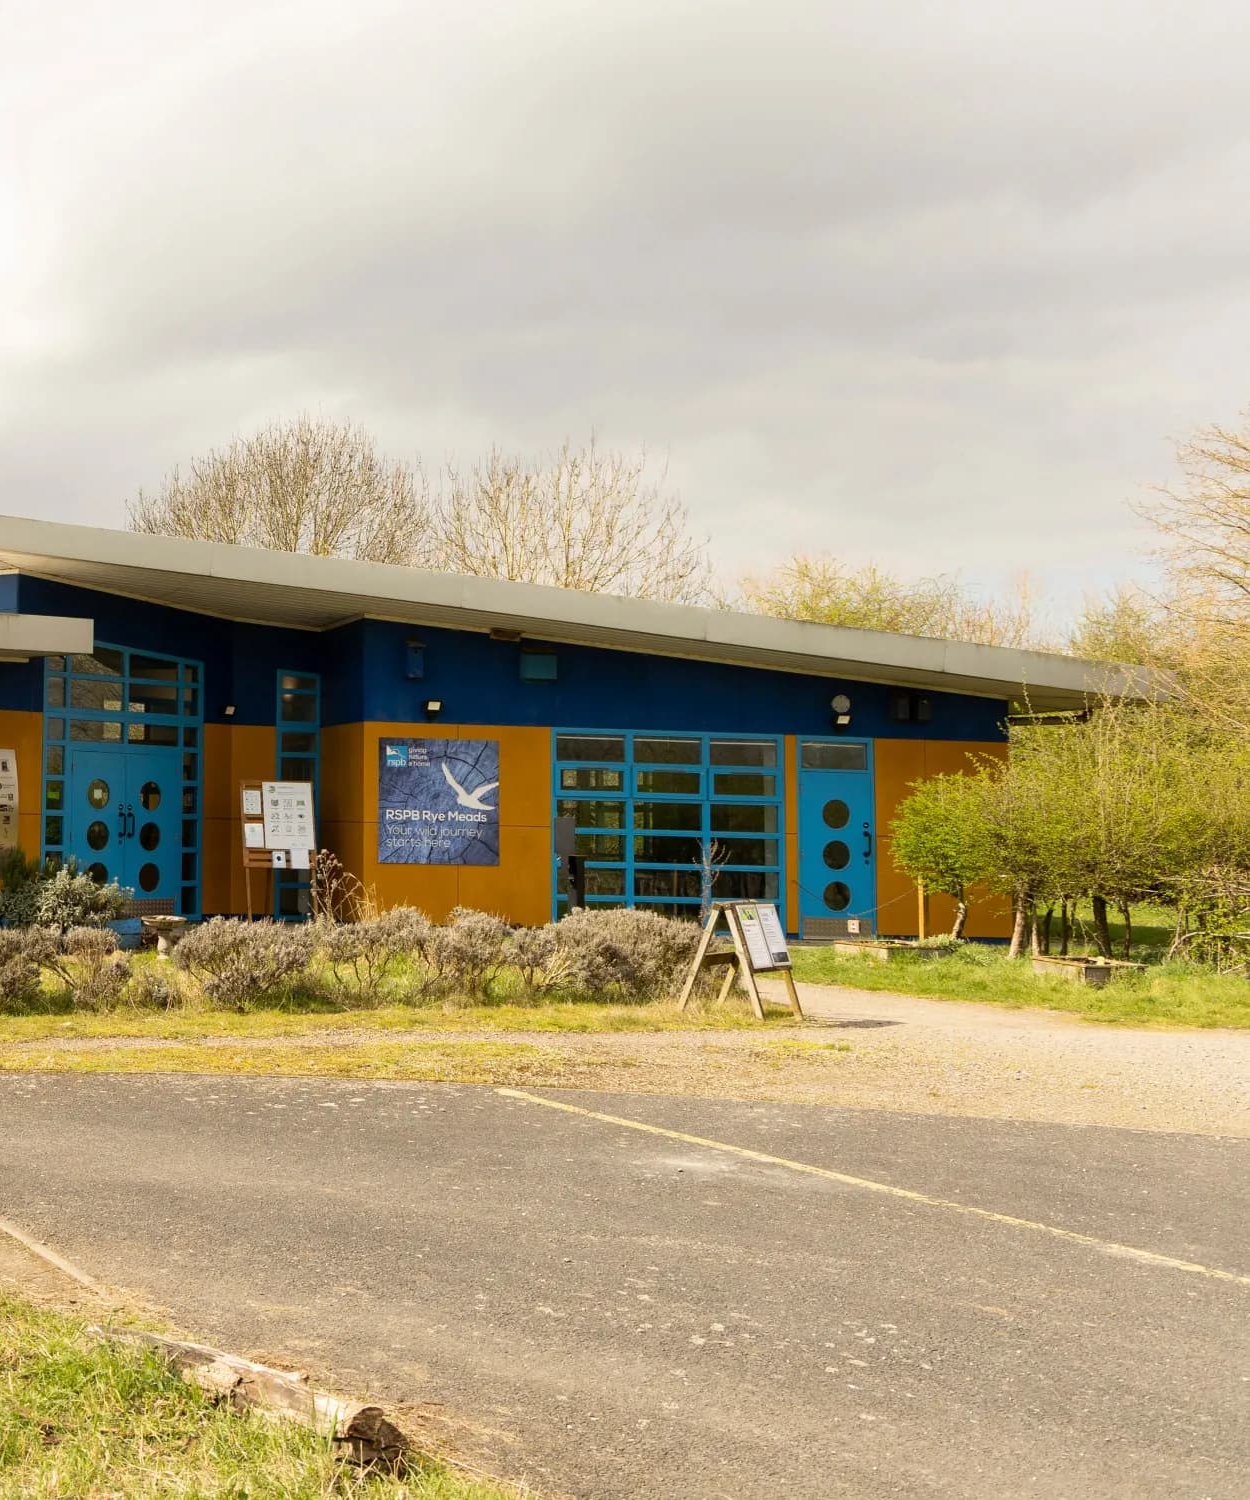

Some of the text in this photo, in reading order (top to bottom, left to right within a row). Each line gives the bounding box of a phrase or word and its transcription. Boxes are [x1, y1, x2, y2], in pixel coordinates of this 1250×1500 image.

[386, 758, 407, 768] rspb
[386, 809, 487, 823] RSPB Rye Meads
[387, 825, 483, 840] Your wild journey
[386, 837, 451, 848] starts here
